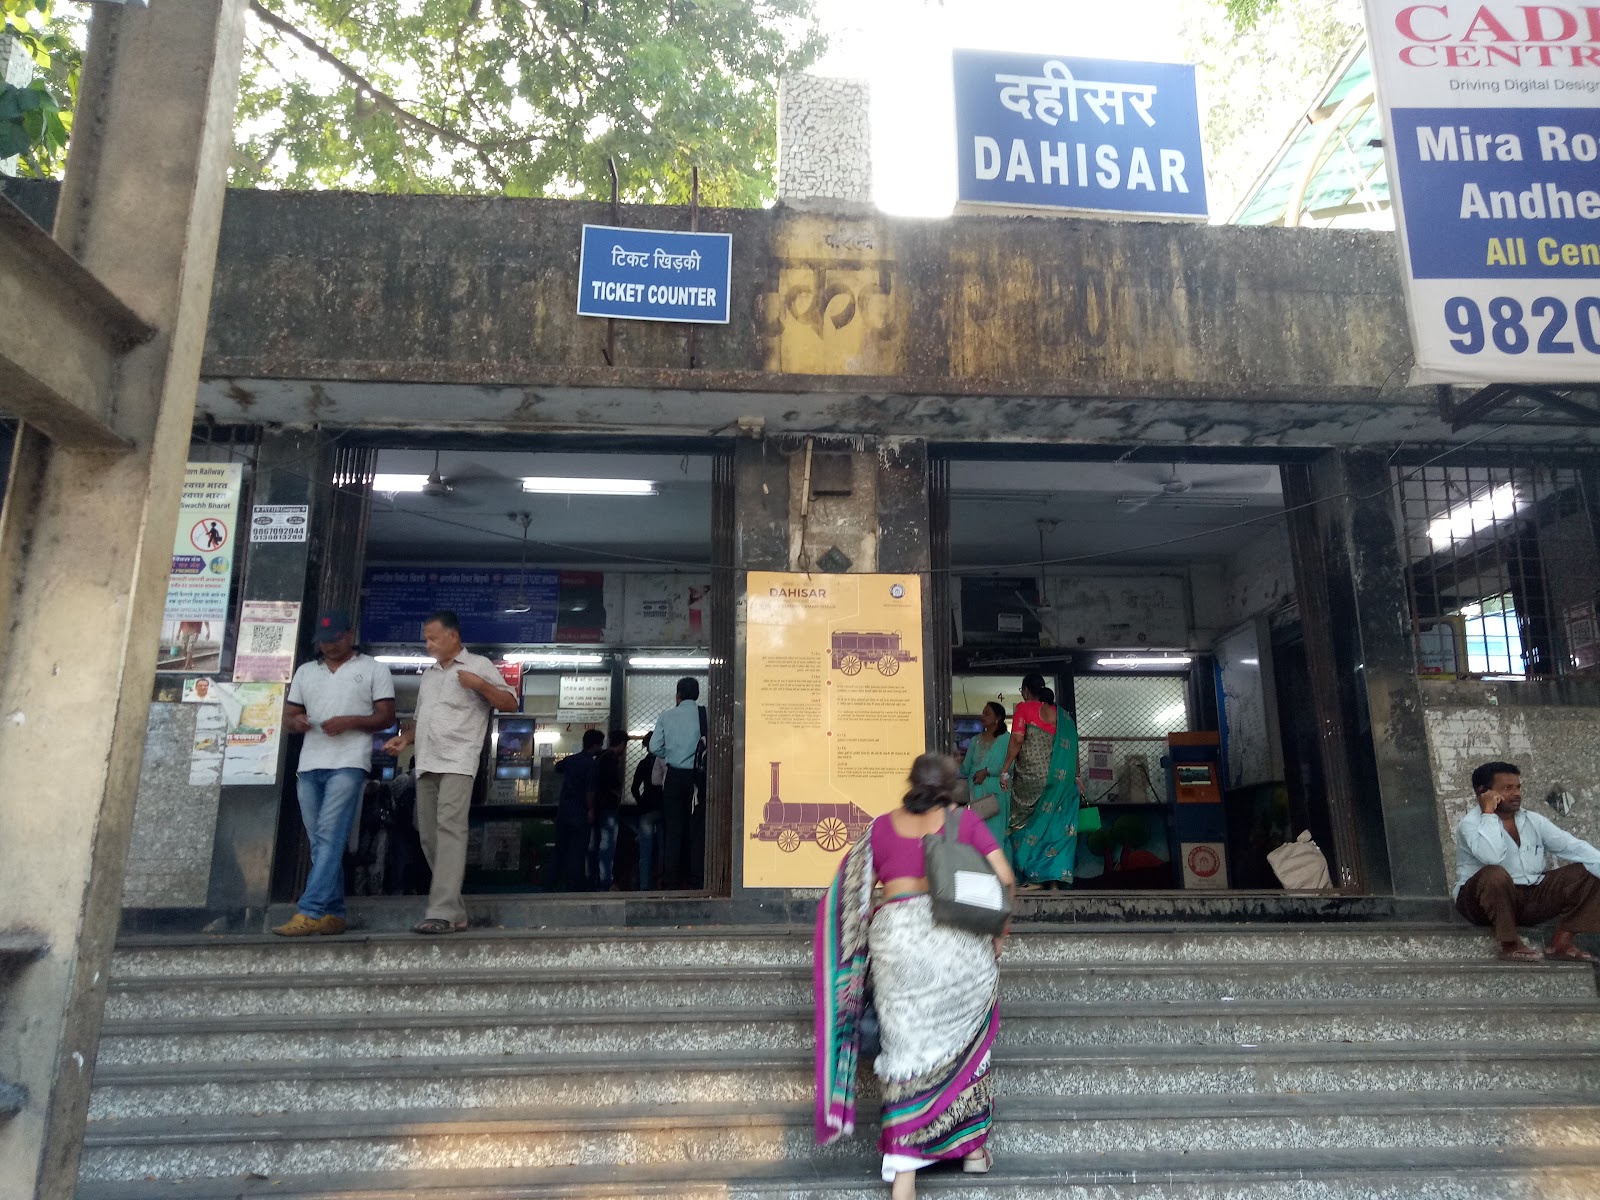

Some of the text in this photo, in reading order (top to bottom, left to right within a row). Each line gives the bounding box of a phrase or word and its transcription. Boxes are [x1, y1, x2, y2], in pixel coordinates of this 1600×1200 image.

[994, 60, 1157, 127] दहीसर
[1449, 79, 1500, 92] Driving
[1504, 79, 1549, 92] Digital
[1416, 126, 1600, 161] Mira Ro
[973, 135, 1190, 194] DAHISAR
[1460, 182, 1600, 219] Andhe
[611, 244, 702, 273] टिकट खिड़की
[1486, 237, 1600, 266] All Cen
[591, 280, 717, 307] TICKET COUNTER
[1444, 296, 1600, 355] 9820
[199, 468, 225, 477] Railway
[207, 502, 231, 510] Bharat
[769, 588, 827, 598] DAHISAR
